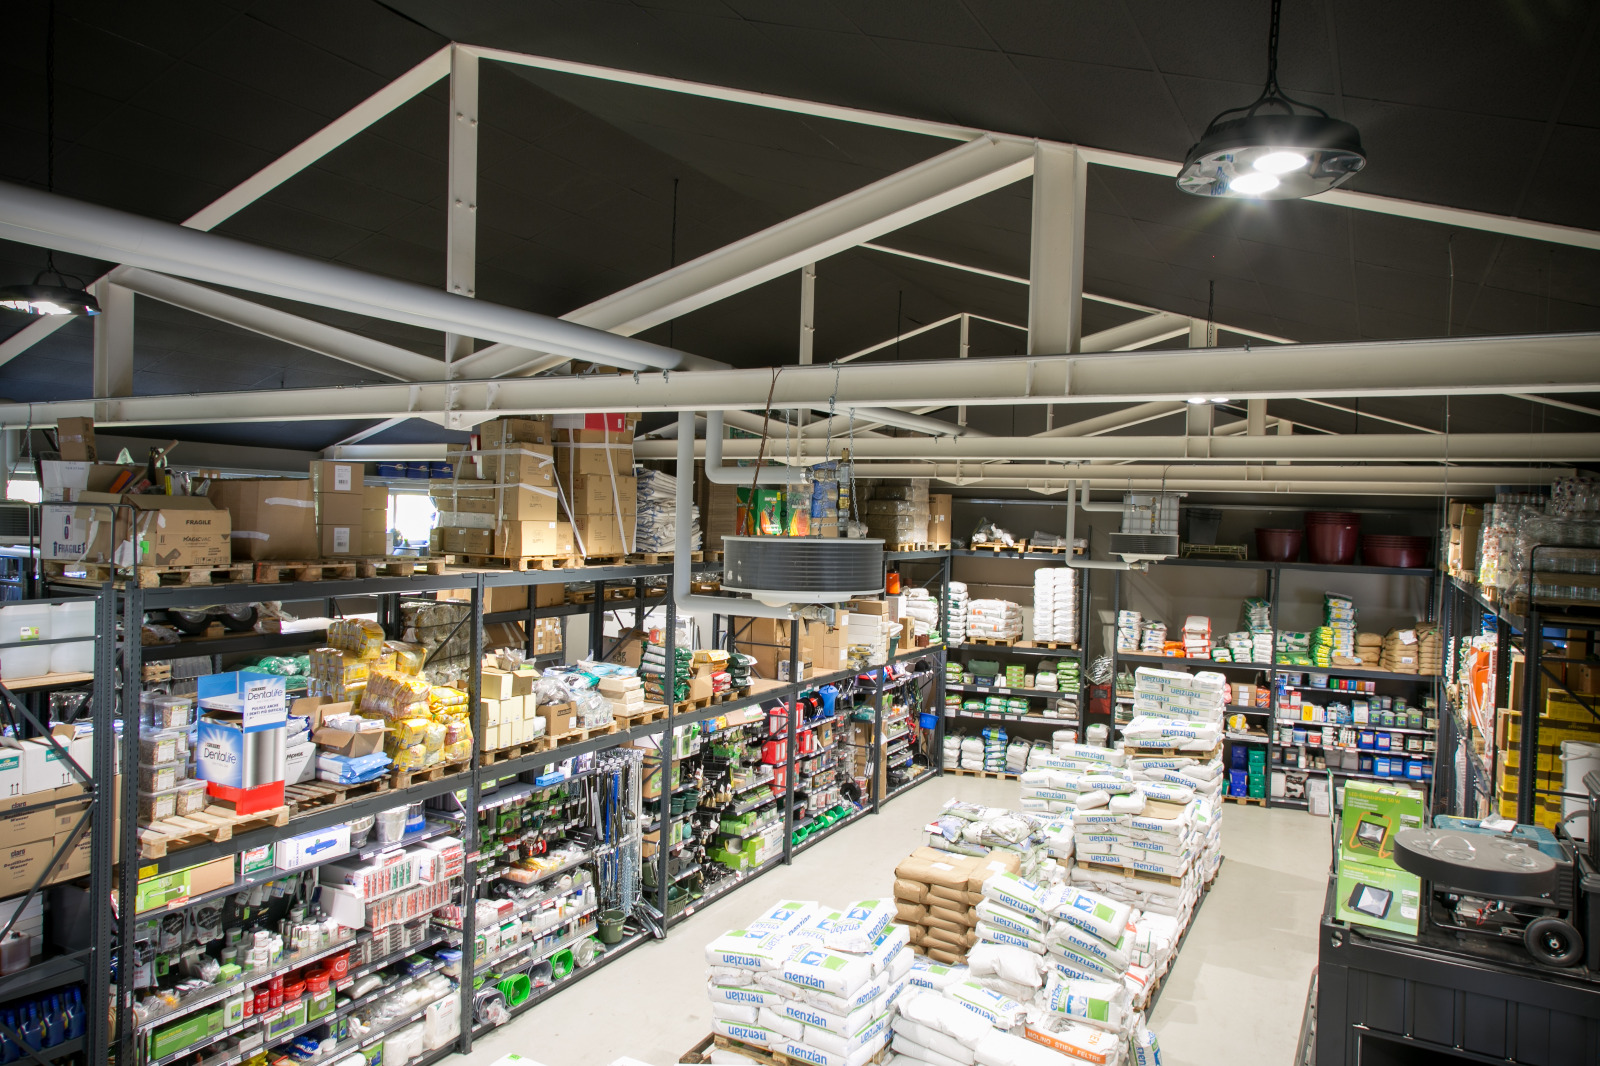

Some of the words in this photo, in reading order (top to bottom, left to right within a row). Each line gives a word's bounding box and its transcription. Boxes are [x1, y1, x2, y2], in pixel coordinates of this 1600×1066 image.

[58, 543, 82, 554] FRAGILE
[11, 849, 26, 858] claro
[1027, 1031, 1052, 1045] MOLINO
[1054, 1039, 1074, 1053] STIEN
[1076, 1047, 1102, 1063] FELTRE
